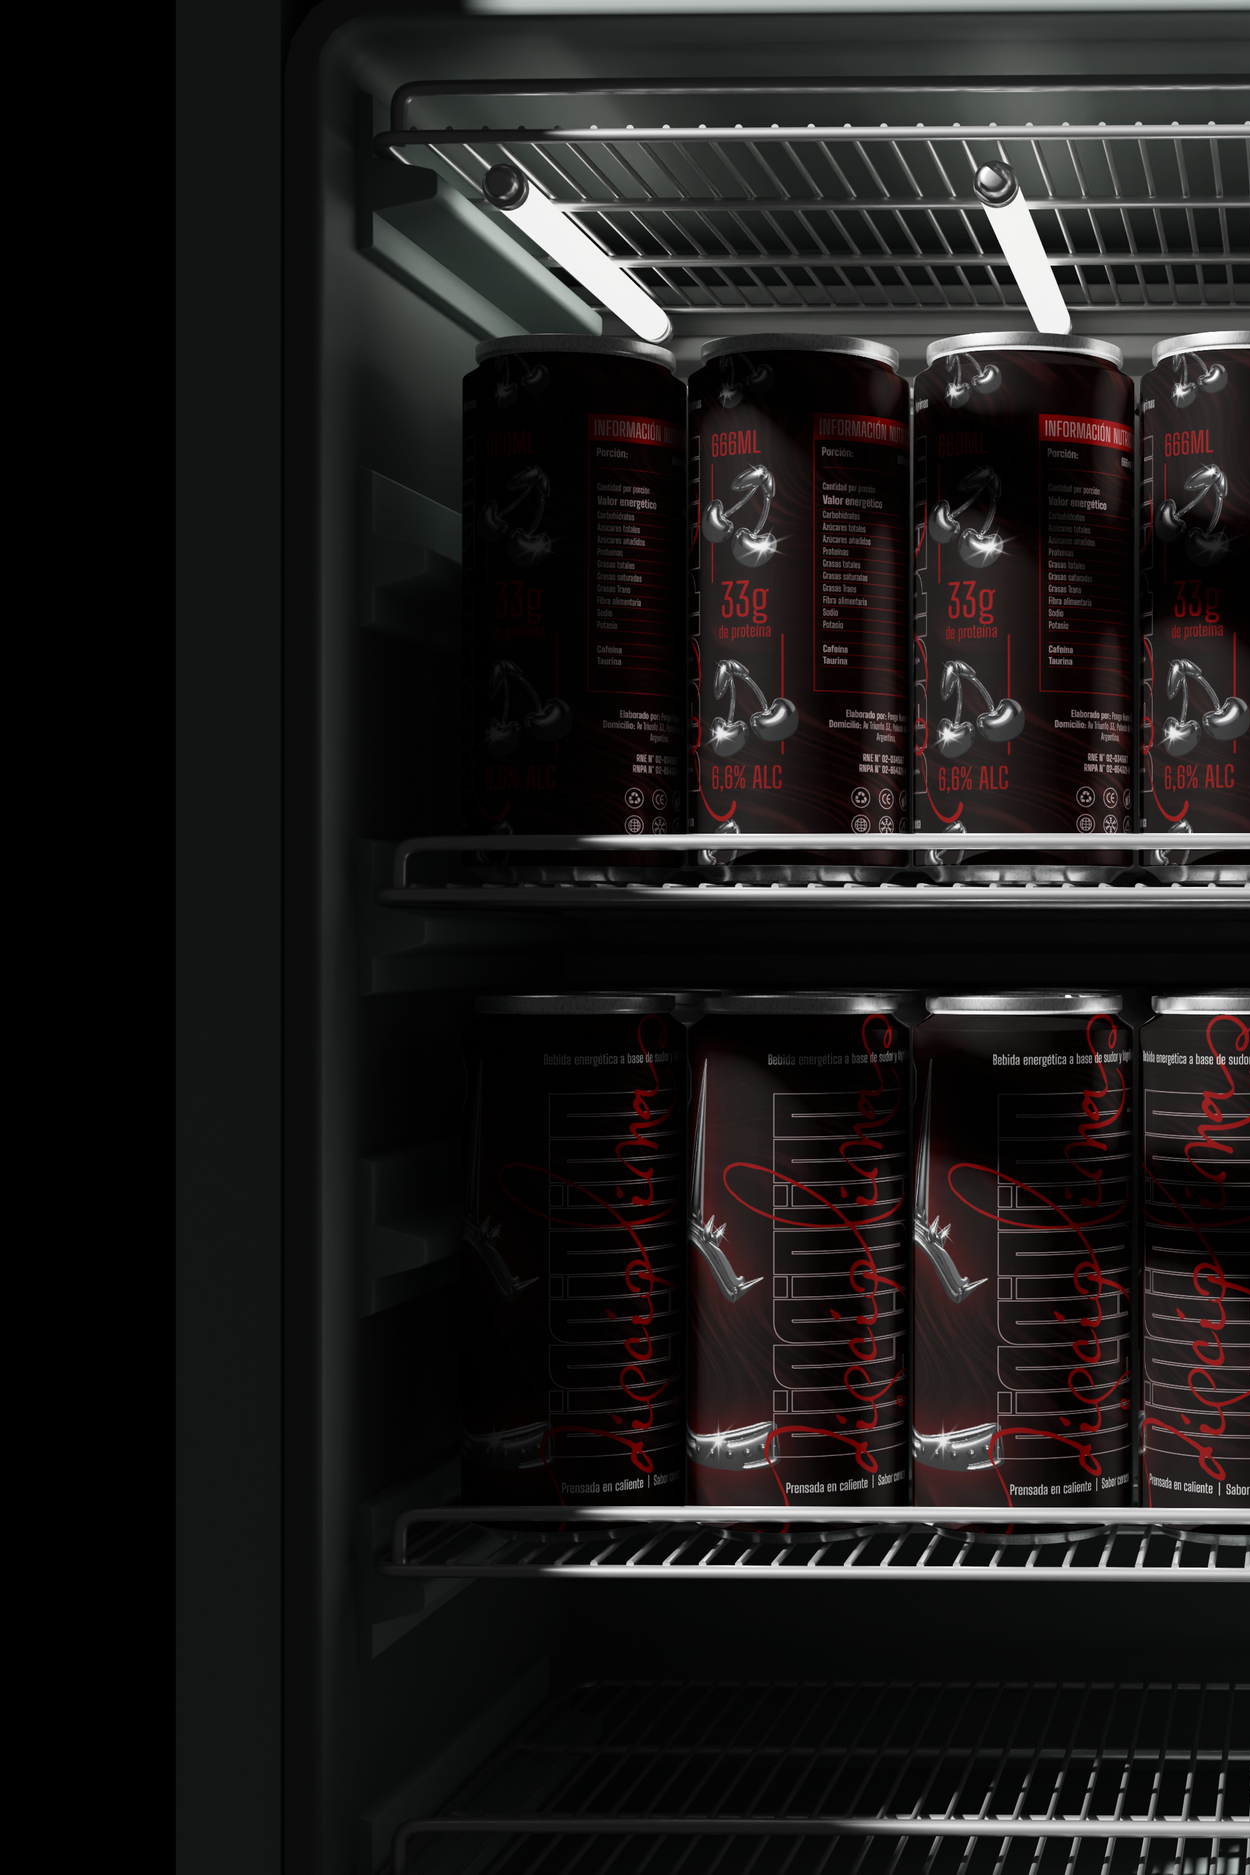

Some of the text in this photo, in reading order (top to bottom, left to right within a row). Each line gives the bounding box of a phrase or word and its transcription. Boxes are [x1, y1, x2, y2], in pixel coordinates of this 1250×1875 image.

[594, 418, 663, 440] INFORMACIÓN
[819, 418, 888, 441] INFORMACIÓN
[1045, 418, 1112, 441] INFORMACIÓN
[711, 429, 762, 458] 666ML
[937, 430, 988, 458] 666ML
[1165, 430, 1213, 457] 666ML
[821, 446, 854, 457] Porción:
[1047, 446, 1079, 459] Porción:
[822, 482, 876, 494] Cantidad por porción
[822, 495, 883, 509] Valor energético
[822, 510, 860, 520] Carbohidratos
[822, 522, 866, 533] Azúcares totales
[822, 534, 871, 546] Azúcares añadidos
[822, 547, 849, 556] Proteínas
[822, 559, 861, 569] Grasas totales
[822, 571, 868, 582] Grasas saturadas
[822, 583, 857, 593] Grasas Trans
[495, 579, 544, 624] 33g
[721, 579, 769, 624] 33g
[823, 595, 868, 606] Fibra alimentaria
[948, 580, 996, 625] 33g
[1174, 580, 1221, 623] 33g
[822, 608, 838, 617] Sodio
[823, 620, 844, 629] Potasio
[1171, 623, 1223, 640] de proteína
[718, 623, 771, 641] de proteína
[945, 623, 998, 641] de proteína
[822, 644, 848, 654] Cafeína
[822, 656, 848, 665] Taurina
[845, 709, 875, 719] Elaborado
[828, 719, 862, 729] Domicilio:
[862, 753, 874, 762] RNE
[859, 763, 874, 773] RNPA
[526, 765, 557, 791] ALC
[711, 765, 782, 793] 6,6% ALC
[938, 765, 1009, 792] 6,6% ALC
[1164, 764, 1234, 792] 6,6% ALC
[992, 1054, 1020, 1066] Bebida
[1023, 1054, 1067, 1068] energética
[1069, 1057, 1074, 1065] a
[1076, 1052, 1093, 1064] base
[1094, 1052, 1102, 1064] de
[1103, 1051, 1118, 1063] sudor
[1156, 1053, 1187, 1066] energética
[1189, 1057, 1194, 1065] a
[1195, 1053, 1214, 1065] base
[1216, 1053, 1226, 1065] de
[1009, 1476, 1117, 1496] Prensada en caliente Sabor
[1149, 1473, 1172, 1490] Prensada
[1174, 1481, 1182, 1491] en
[1184, 1480, 1213, 1494] caliente
[1226, 1483, 1250, 1496] Sabor
